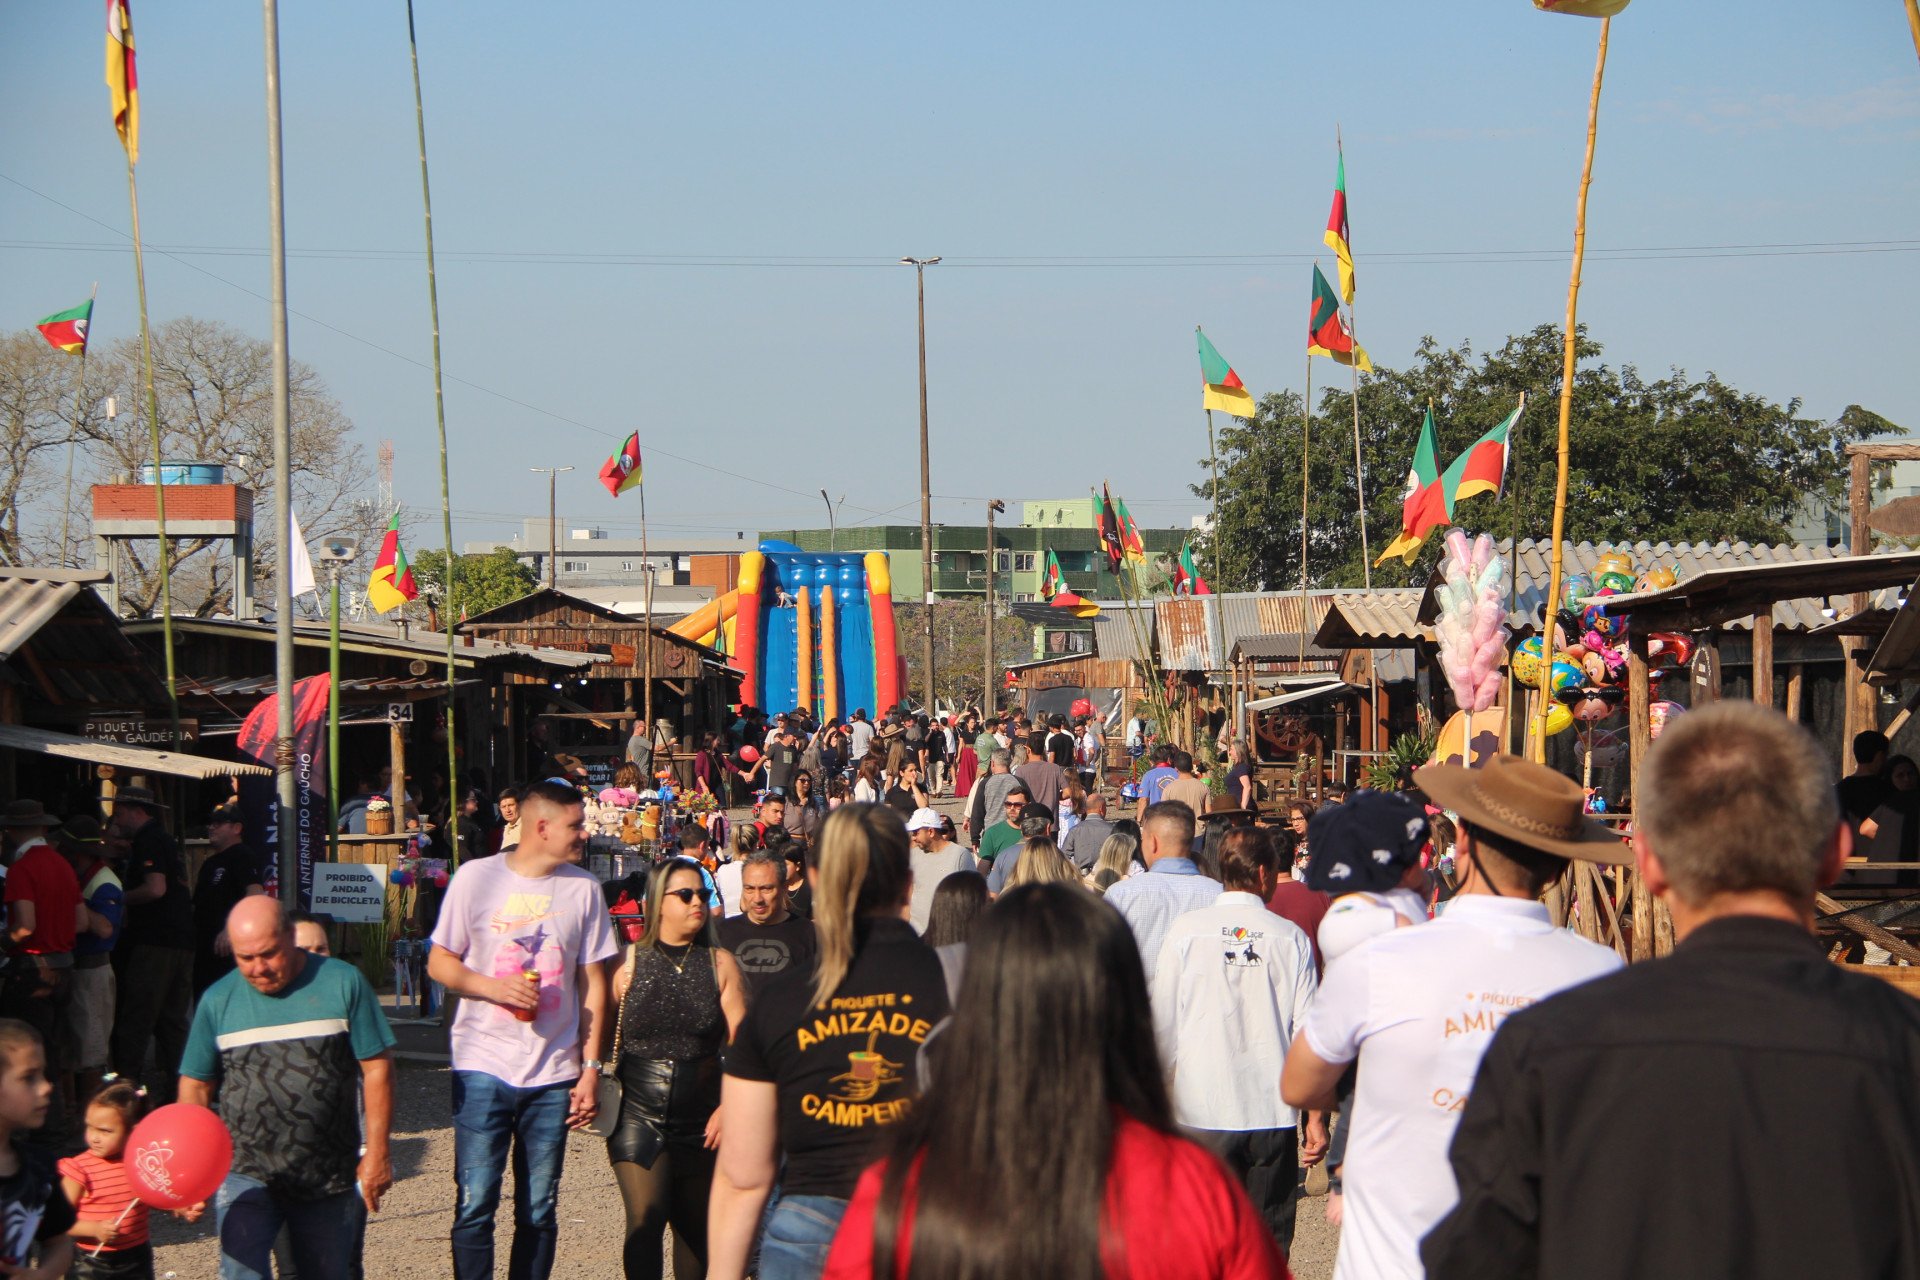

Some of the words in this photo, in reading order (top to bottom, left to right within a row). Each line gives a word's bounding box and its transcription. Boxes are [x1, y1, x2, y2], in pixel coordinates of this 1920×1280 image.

[391, 704, 411, 720] 34
[86, 722, 146, 732] PIQUETE
[85, 732, 118, 743] MA
[299, 753, 312, 806] GAÚCHO
[300, 807, 310, 828] DO
[300, 829, 311, 884] INTERNET
[325, 874, 374, 882] PROIBIDO
[301, 886, 312, 896] A
[330, 885, 367, 893] ANDAR
[315, 896, 329, 904] DE
[330, 896, 381, 905] BICICLETA
[1222, 926, 1233, 937] Eu
[831, 993, 897, 1010] PIQUETE
[797, 1009, 932, 1051] AMIZADE
